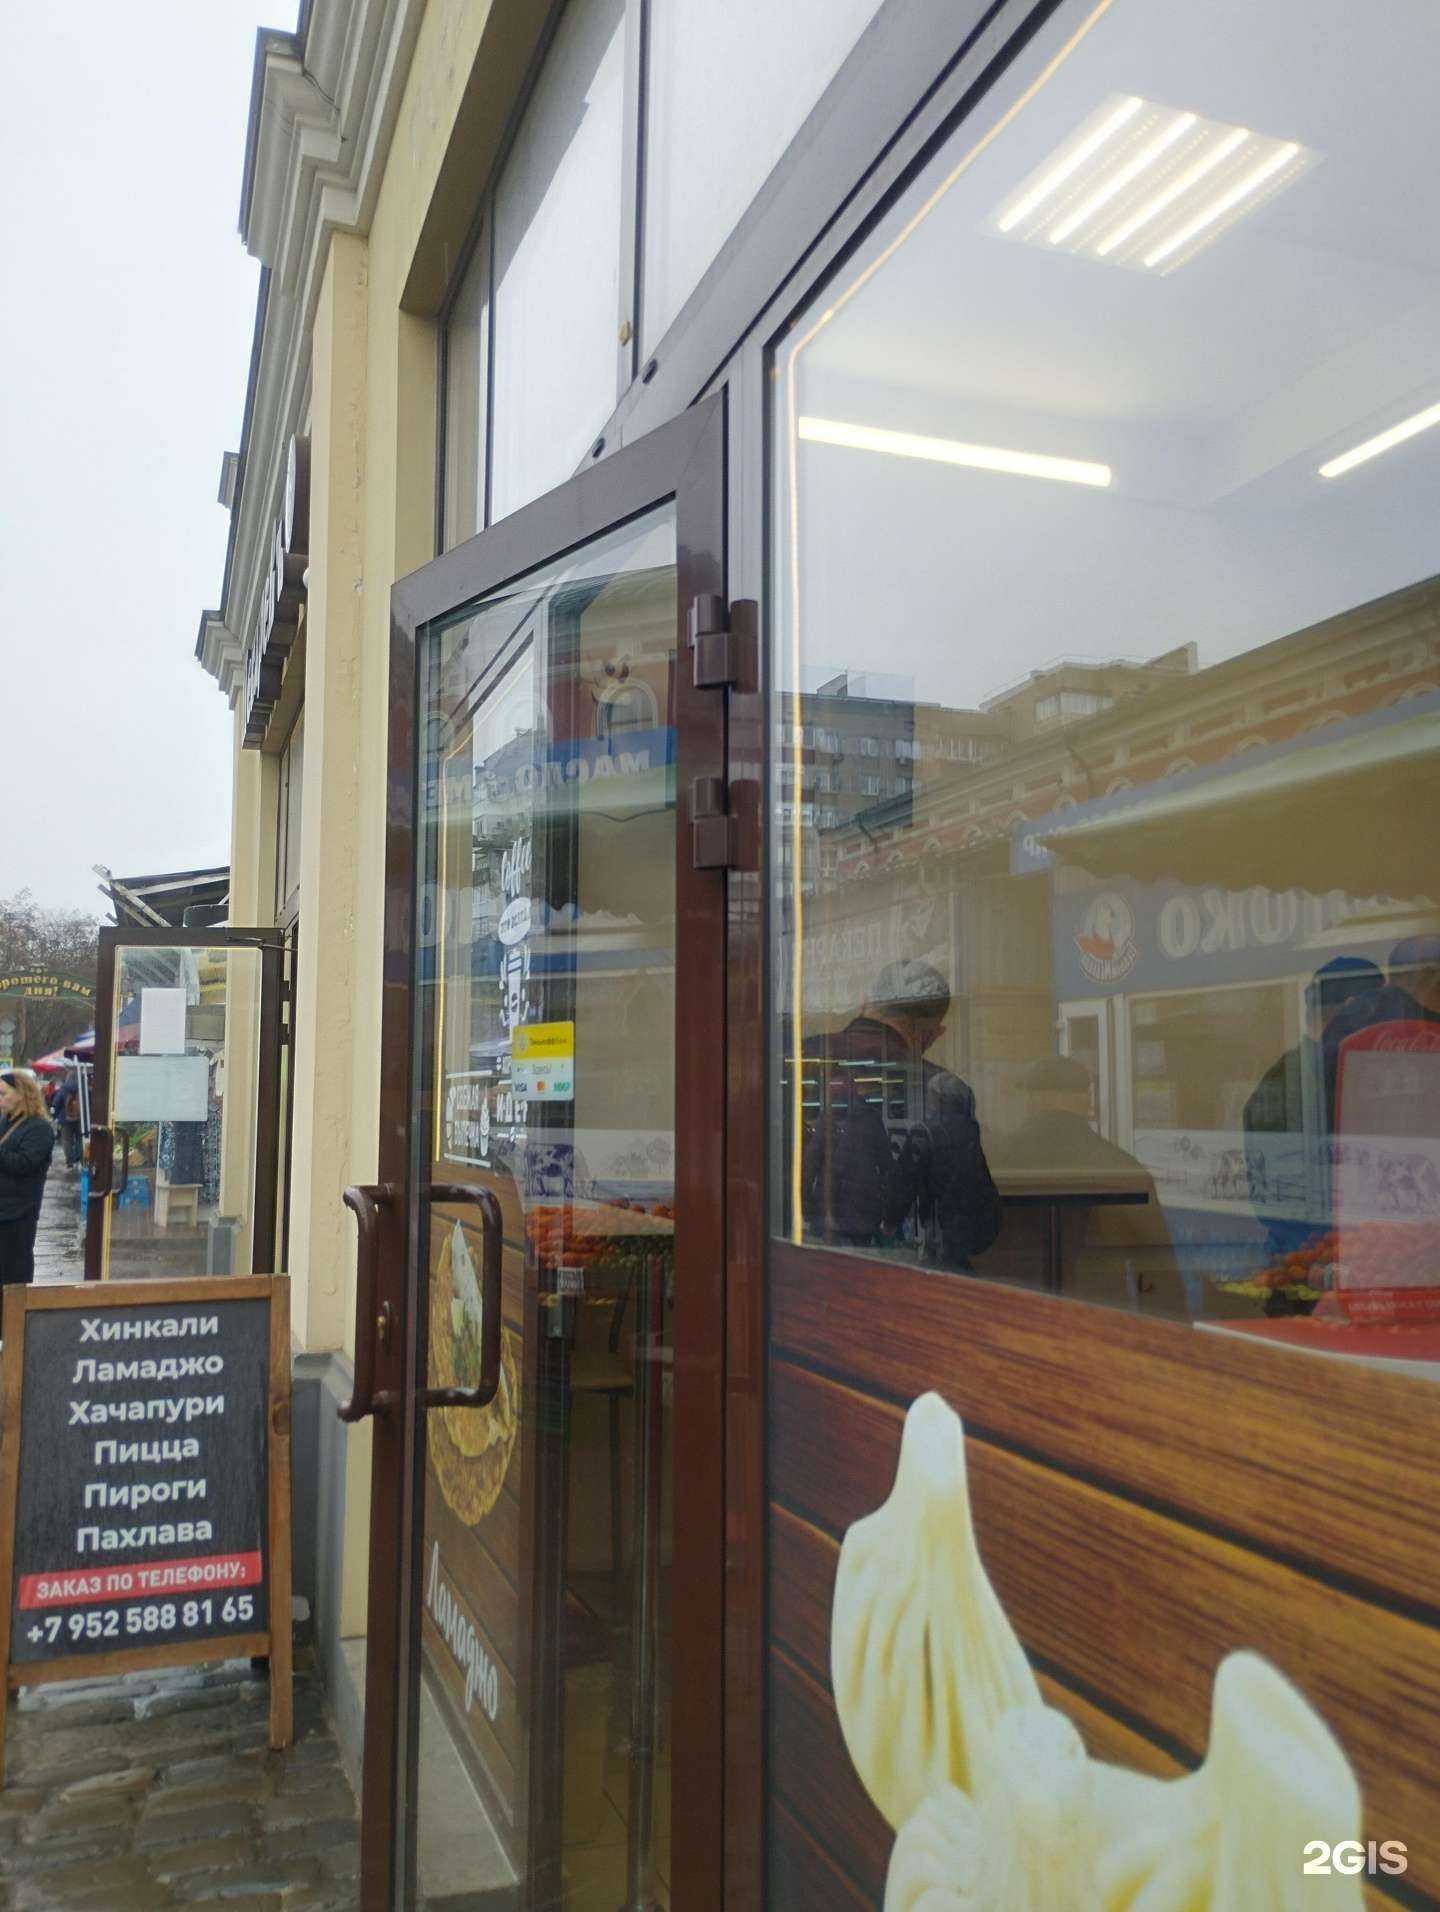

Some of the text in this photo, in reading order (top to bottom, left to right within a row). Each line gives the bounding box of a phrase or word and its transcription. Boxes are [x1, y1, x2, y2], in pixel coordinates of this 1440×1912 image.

[0, 976, 92, 997] рошего вам
[80, 1316, 219, 1343] Хинкали
[73, 1354, 224, 1384] Ламаджо
[68, 1394, 225, 1426] Хачапури
[94, 1437, 200, 1465] Пицца
[84, 1479, 207, 1510] Пироги
[77, 1520, 213, 1553] Пахлава
[36, 1560, 247, 1600] ЗАКАЗ ПО ТЕЛЕФОНУ:
[27, 1595, 254, 1644] +7 952 588 81 65
[427, 1539, 498, 1722] Ламаджо
